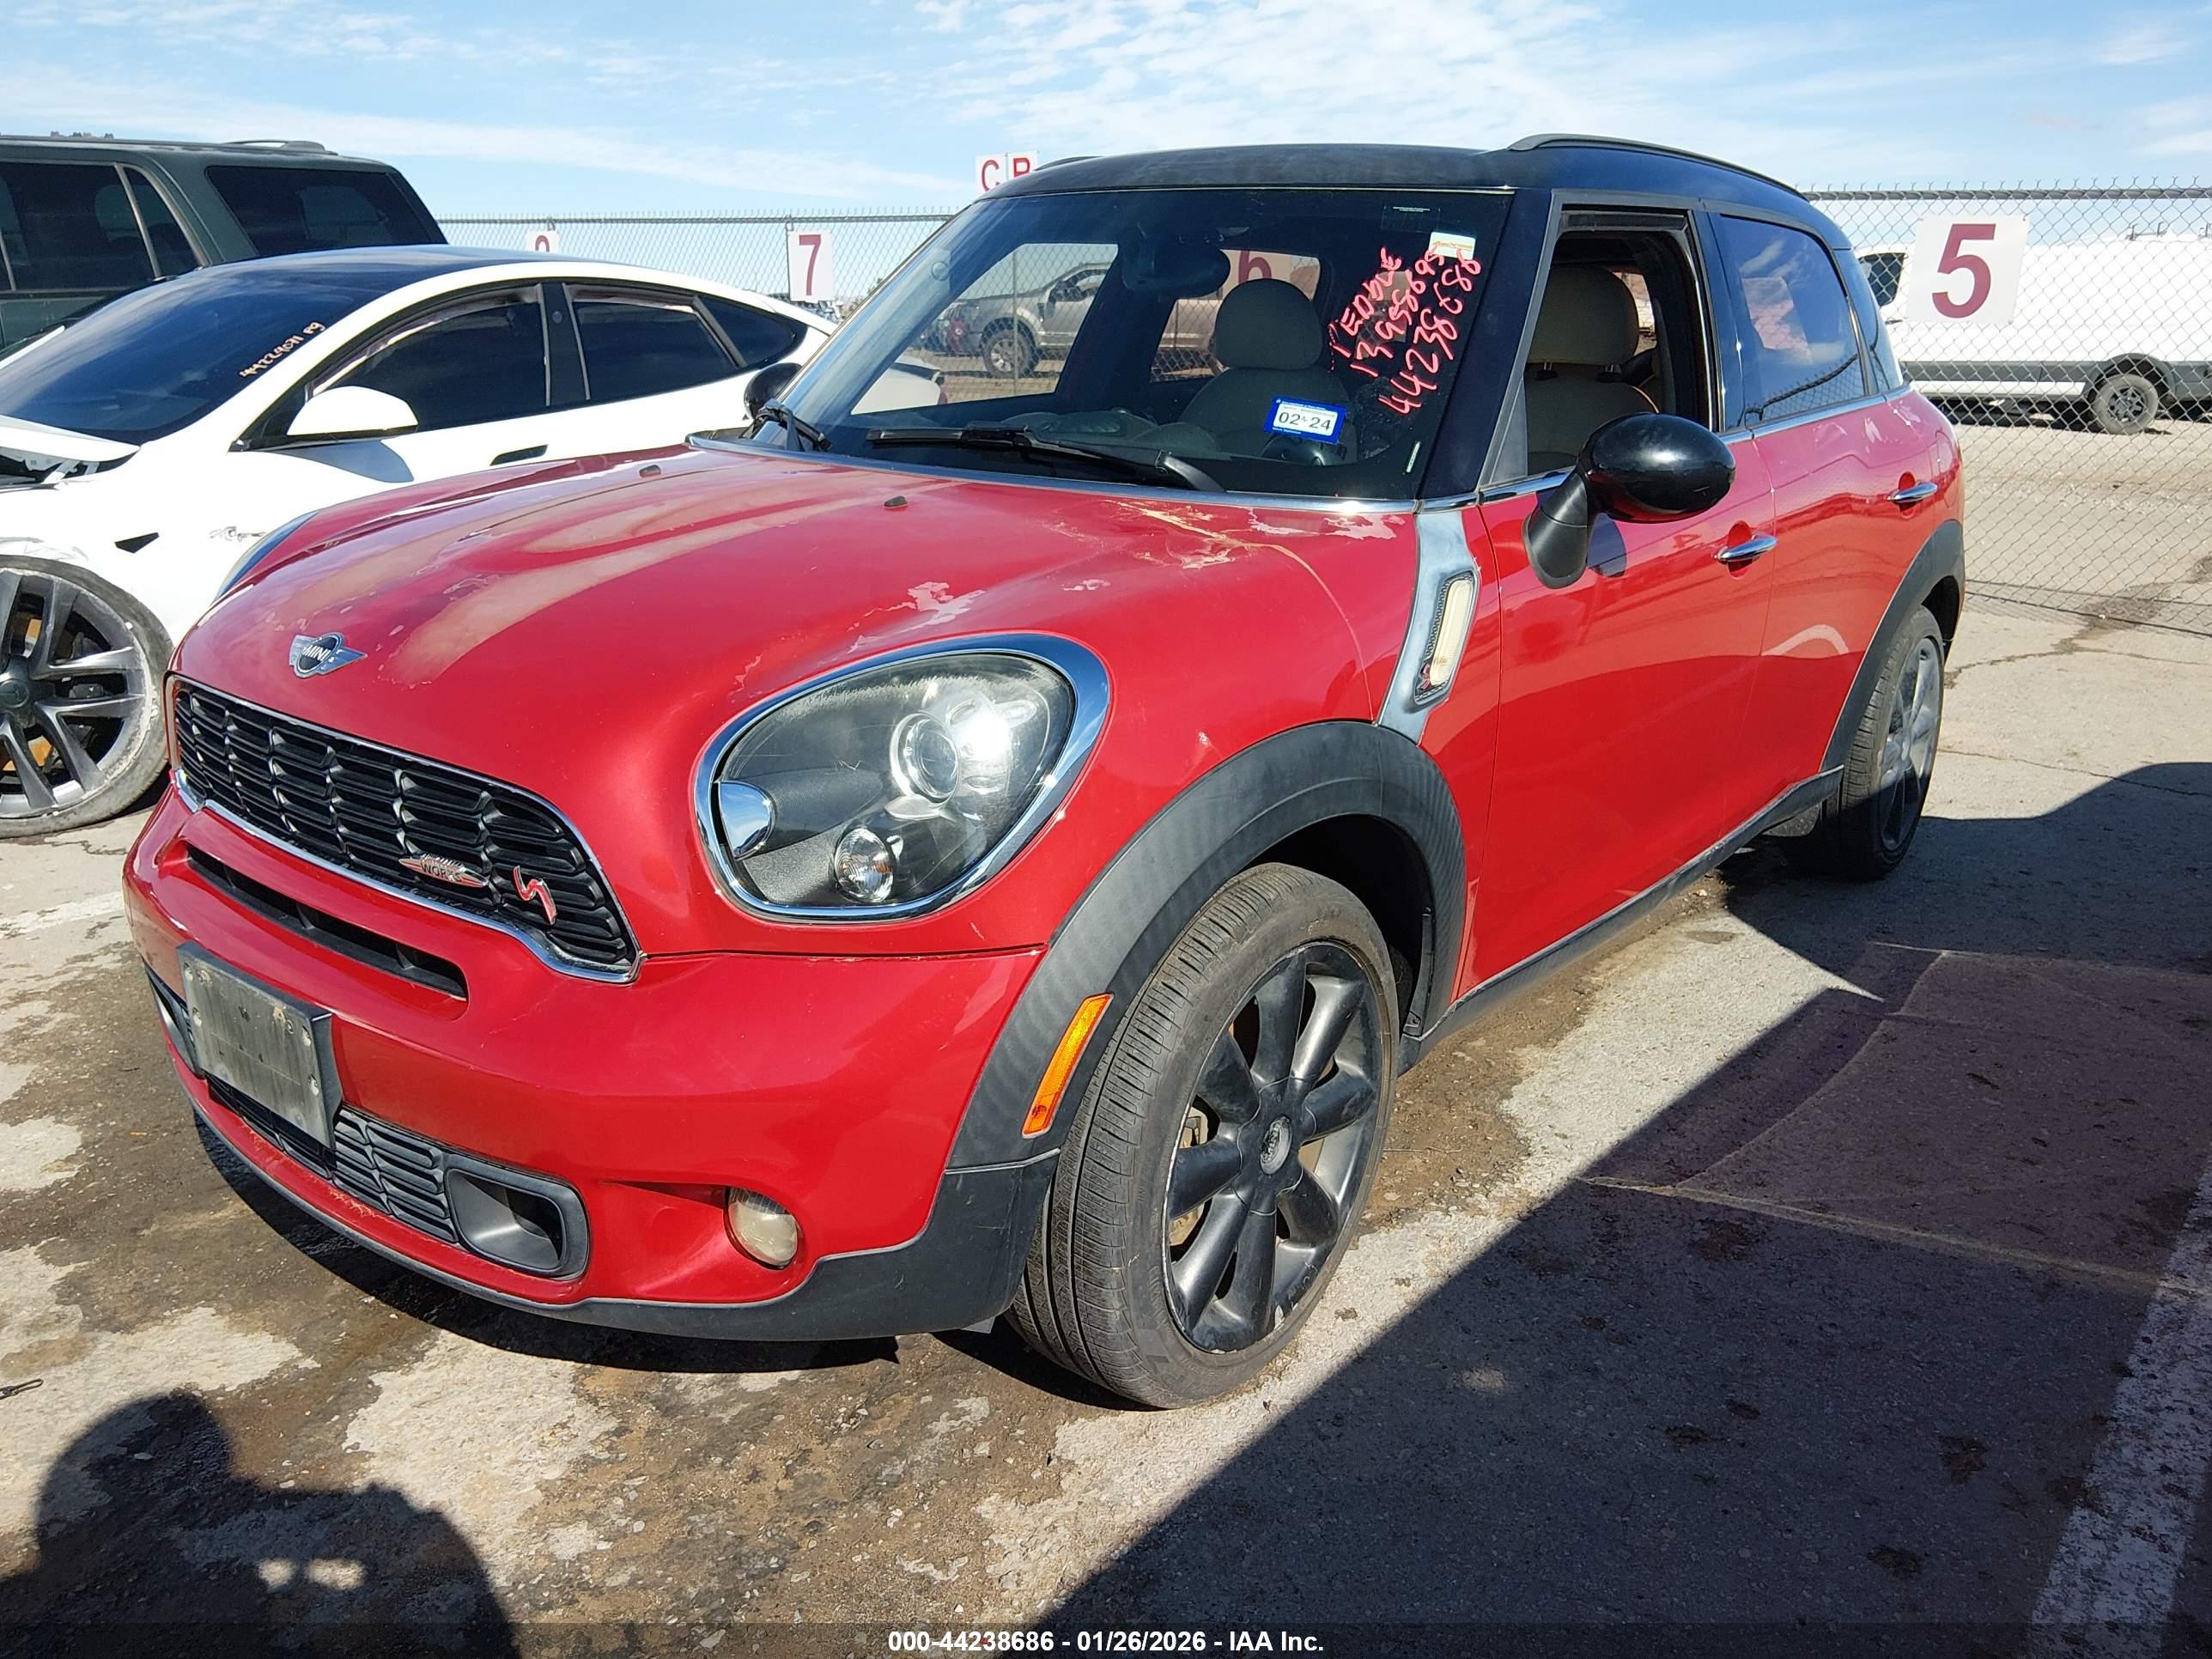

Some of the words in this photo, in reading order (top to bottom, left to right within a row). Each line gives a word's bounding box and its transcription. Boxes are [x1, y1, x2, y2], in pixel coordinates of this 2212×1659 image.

[799, 234, 822, 296] 7
[1931, 223, 1996, 319] 5
[301, 644, 332, 662] MINI
